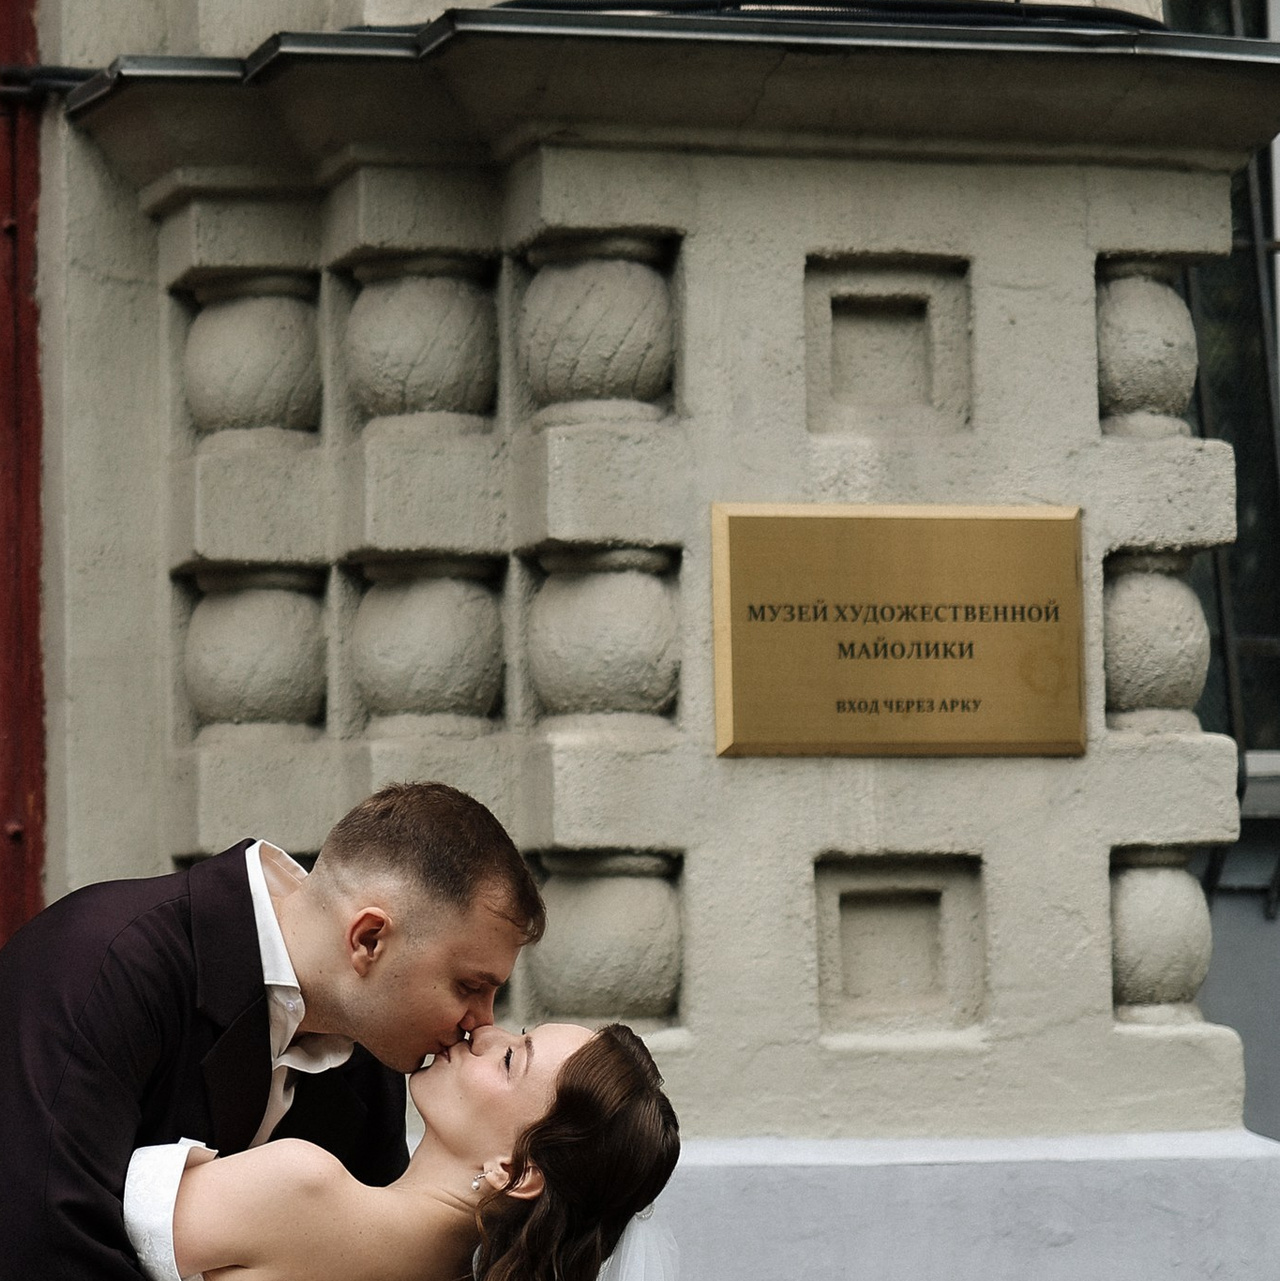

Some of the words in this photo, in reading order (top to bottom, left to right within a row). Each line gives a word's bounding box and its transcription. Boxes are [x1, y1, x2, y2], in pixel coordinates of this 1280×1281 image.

[747, 599, 828, 623] МУЗЕЙ
[834, 599, 1061, 625] ХУДОЖЕСТВЕННОЙ
[837, 637, 974, 660] МАЙОЛИКИ
[836, 700, 880, 715] ВХОД
[883, 700, 935, 714] ЧЕРЕЗ
[940, 700, 982, 714] АРКУ
